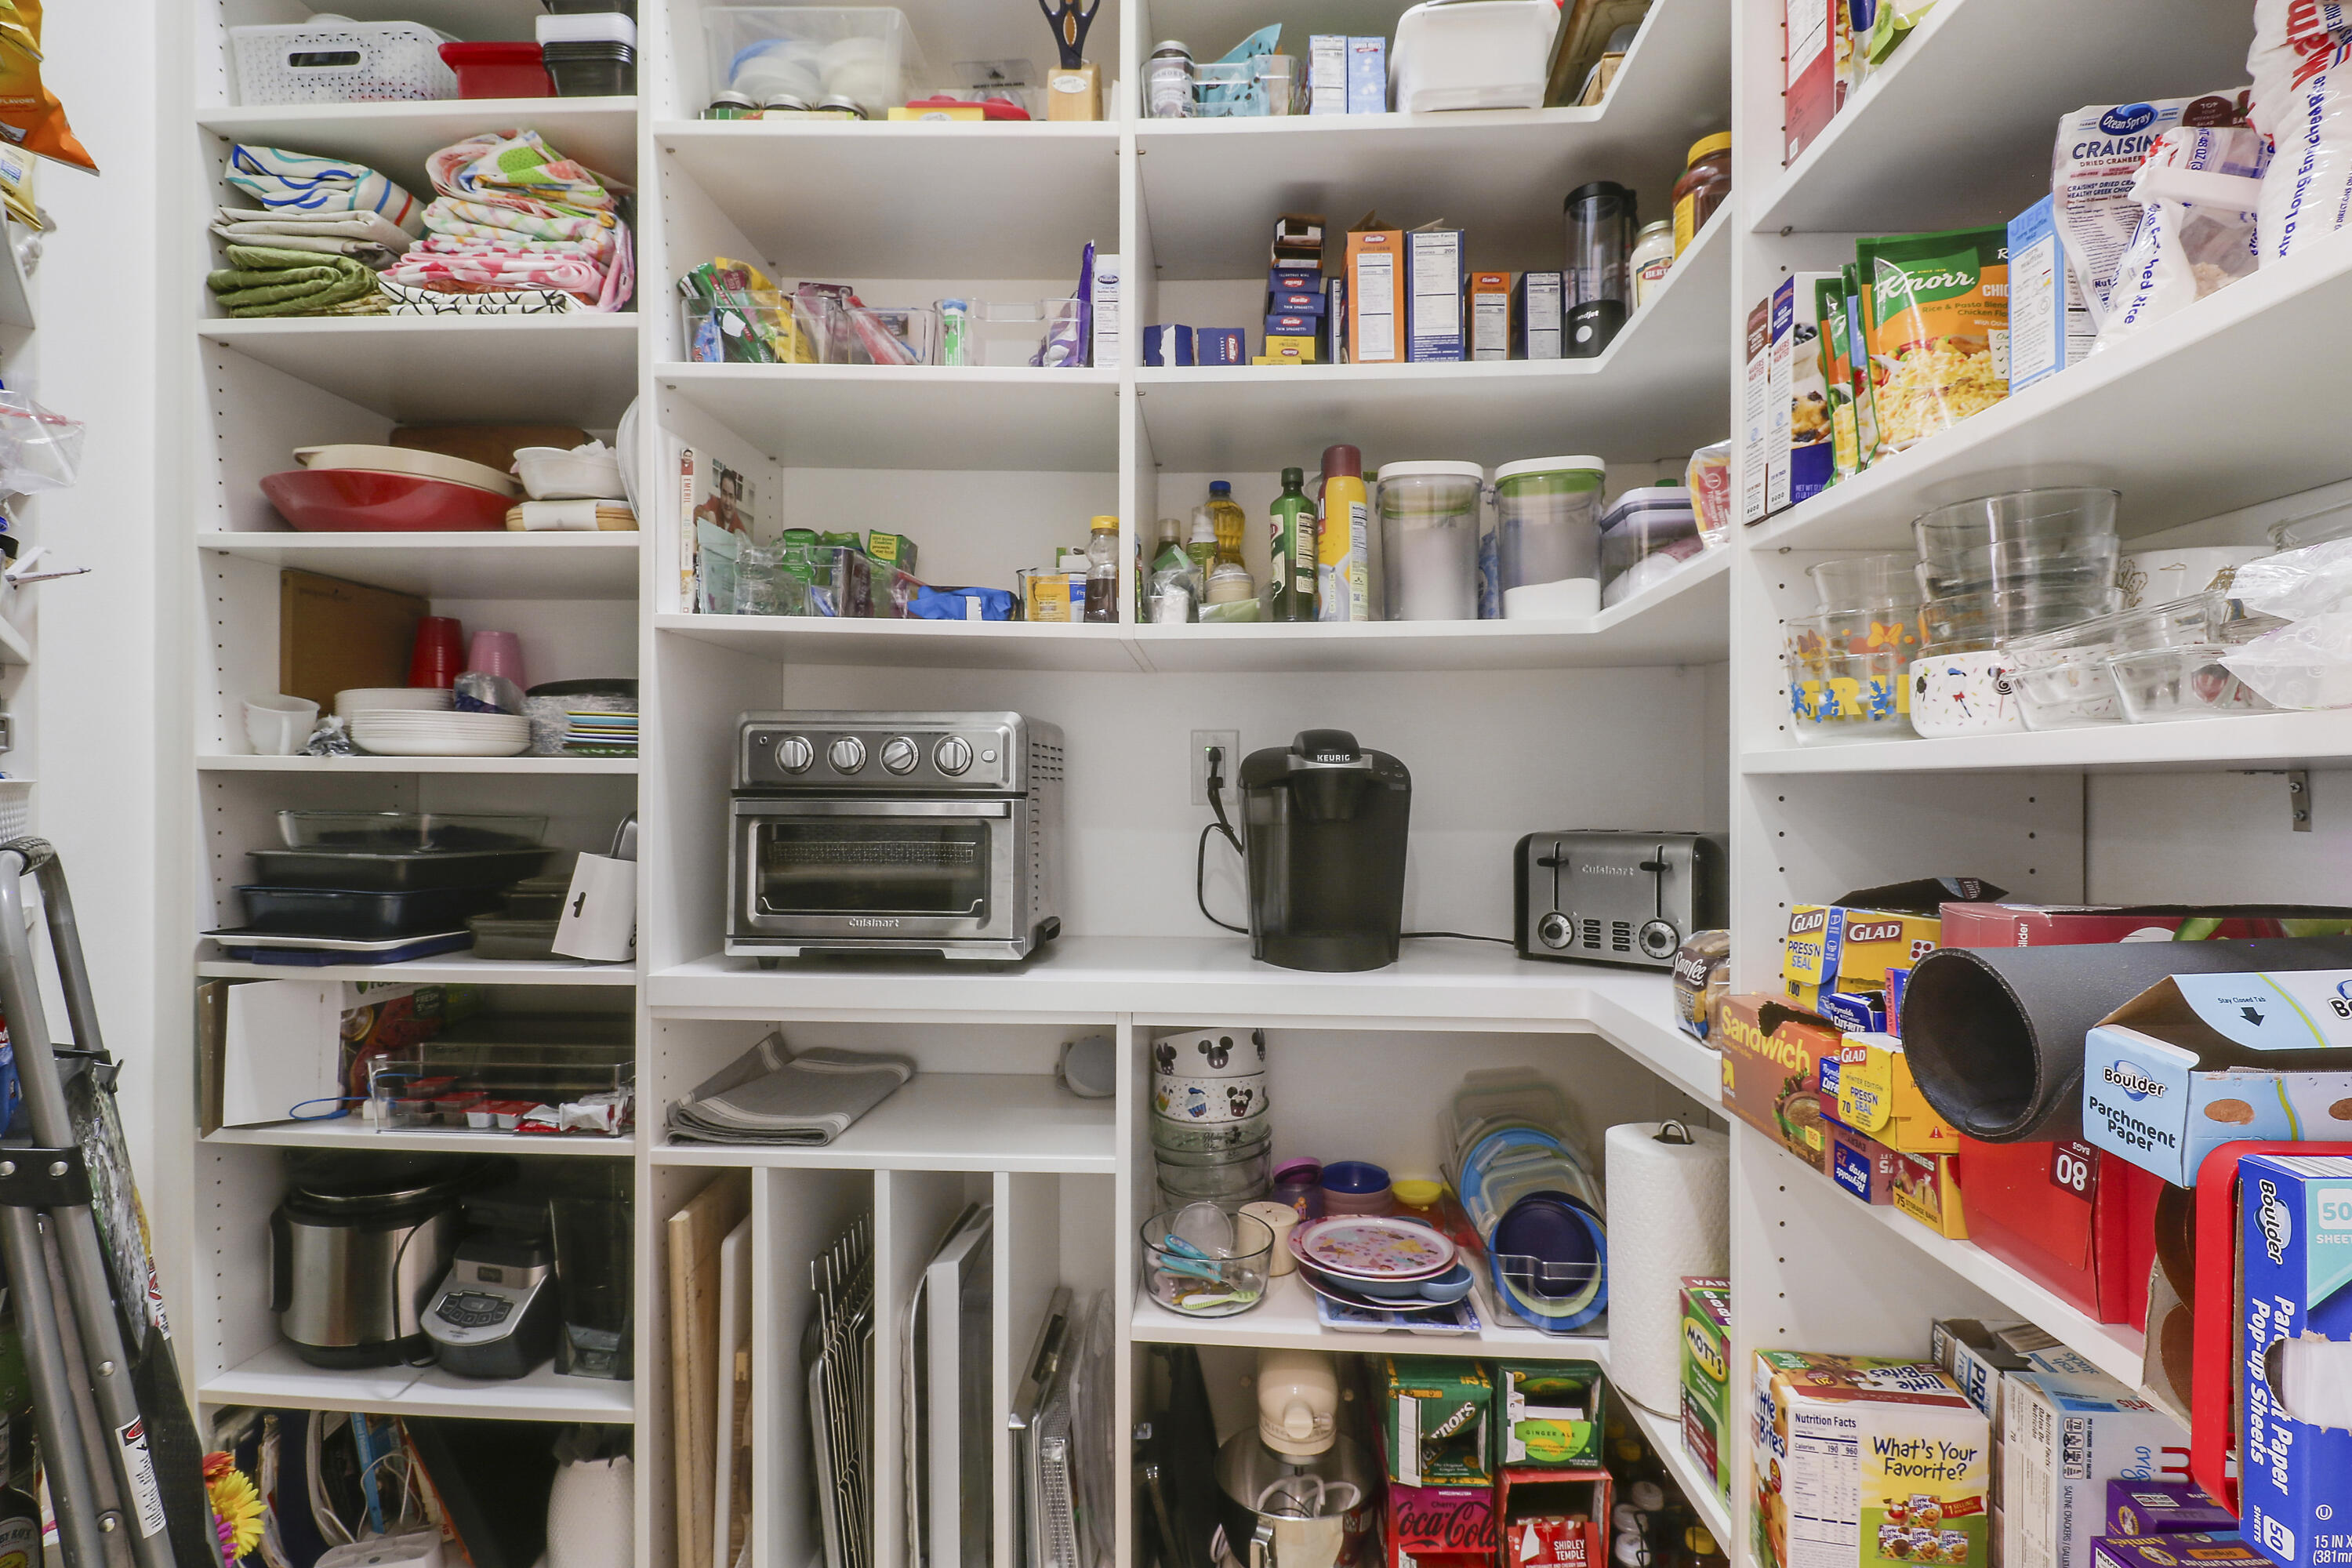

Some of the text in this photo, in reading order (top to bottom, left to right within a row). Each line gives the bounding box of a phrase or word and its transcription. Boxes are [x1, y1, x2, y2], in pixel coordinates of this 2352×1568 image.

[2103, 111, 2151, 131] Ocean Spray
[2285, 178, 2311, 219] Long
[1874, 270, 1976, 303] Knorr
[1922, 304, 1944, 313] Rice
[683, 478, 691, 503] EMERIL
[1581, 863, 1634, 877] Cuisinart
[849, 917, 900, 928] Cuisinart
[1791, 913, 1822, 933] GLAD
[1849, 924, 1900, 941] GLAD
[1791, 955, 1813, 971] SEAL
[1788, 981, 1800, 996] 100
[1834, 1018, 1865, 1033] CUT-RITE
[1842, 1048, 1866, 1062] GLAD
[1865, 1080, 1884, 1091] EDITION
[2103, 1069, 2165, 1097] Boulder
[1842, 1099, 1872, 1115] 70 SEAL
[2089, 1095, 2176, 1149] Parchment
[2107, 1120, 2154, 1152] Paper
[2072, 1142, 2090, 1155] BAGS
[1836, 1167, 1866, 1193] Reynolds
[1849, 1163, 1868, 1184] Wrap
[2056, 1153, 2088, 1191] 80
[1896, 1193, 1905, 1207] 75
[2322, 1202, 2352, 1221] 50
[2259, 1179, 2283, 1265] Boulder
[1869, 1367, 1920, 1378] Bites
[1896, 1374, 1945, 1392] Little
[2247, 1298, 2270, 1466] Pop-up Sheets
[1795, 1414, 1857, 1428] Nutrition Facts
[1759, 1415, 1786, 1459] Bites
[1795, 1443, 1816, 1451] Calories
[1827, 1445, 1838, 1454] 190
[1873, 1436, 1977, 1461] What's Your
[1884, 1458, 1966, 1481] Favorite?
[2270, 1427, 2293, 1496] Paper
[1431, 1501, 1457, 1509] Cherry
[2063, 1485, 2073, 1541] SALTINE CRACKERS
[2252, 1504, 2283, 1552] SHEETS 50
[1554, 1540, 1584, 1550] SHIRLEY
[2314, 1534, 2328, 1548] 15
[2332, 1534, 2343, 1548] IN
[1556, 1549, 1585, 1560] TEMPLE
